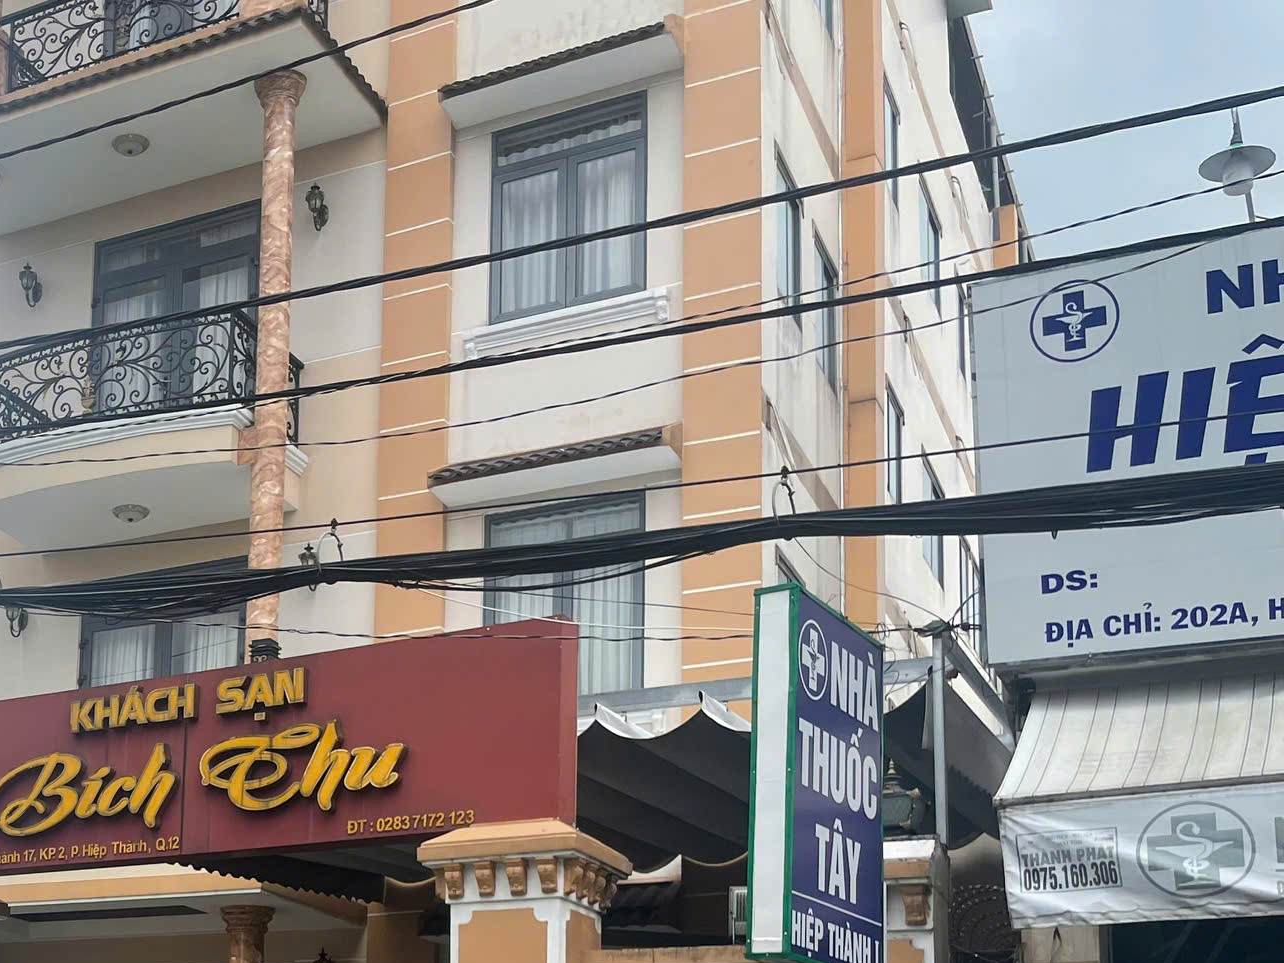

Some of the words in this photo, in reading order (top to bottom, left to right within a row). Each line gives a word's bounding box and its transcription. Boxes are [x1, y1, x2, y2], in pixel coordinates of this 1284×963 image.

[1040, 568, 1099, 595] DS:
[1044, 619, 1094, 648] ĐỊA
[1102, 602, 1161, 638] CHỈ:
[1170, 600, 1258, 630] 202A,
[69, 682, 199, 735] KHÁCH
[215, 666, 307, 722] SẠN
[830, 640, 879, 732] NHÀ
[200, 719, 407, 812] Thu
[799, 717, 878, 820] THUỐC
[23, 848, 37, 863] 17,
[82, 842, 107, 859] Hiệp
[156, 836, 180, 852] Q.12
[815, 821, 862, 905] TÂY
[1023, 860, 1119, 891] 0975.160.306
[791, 907, 824, 958] HIỆP
